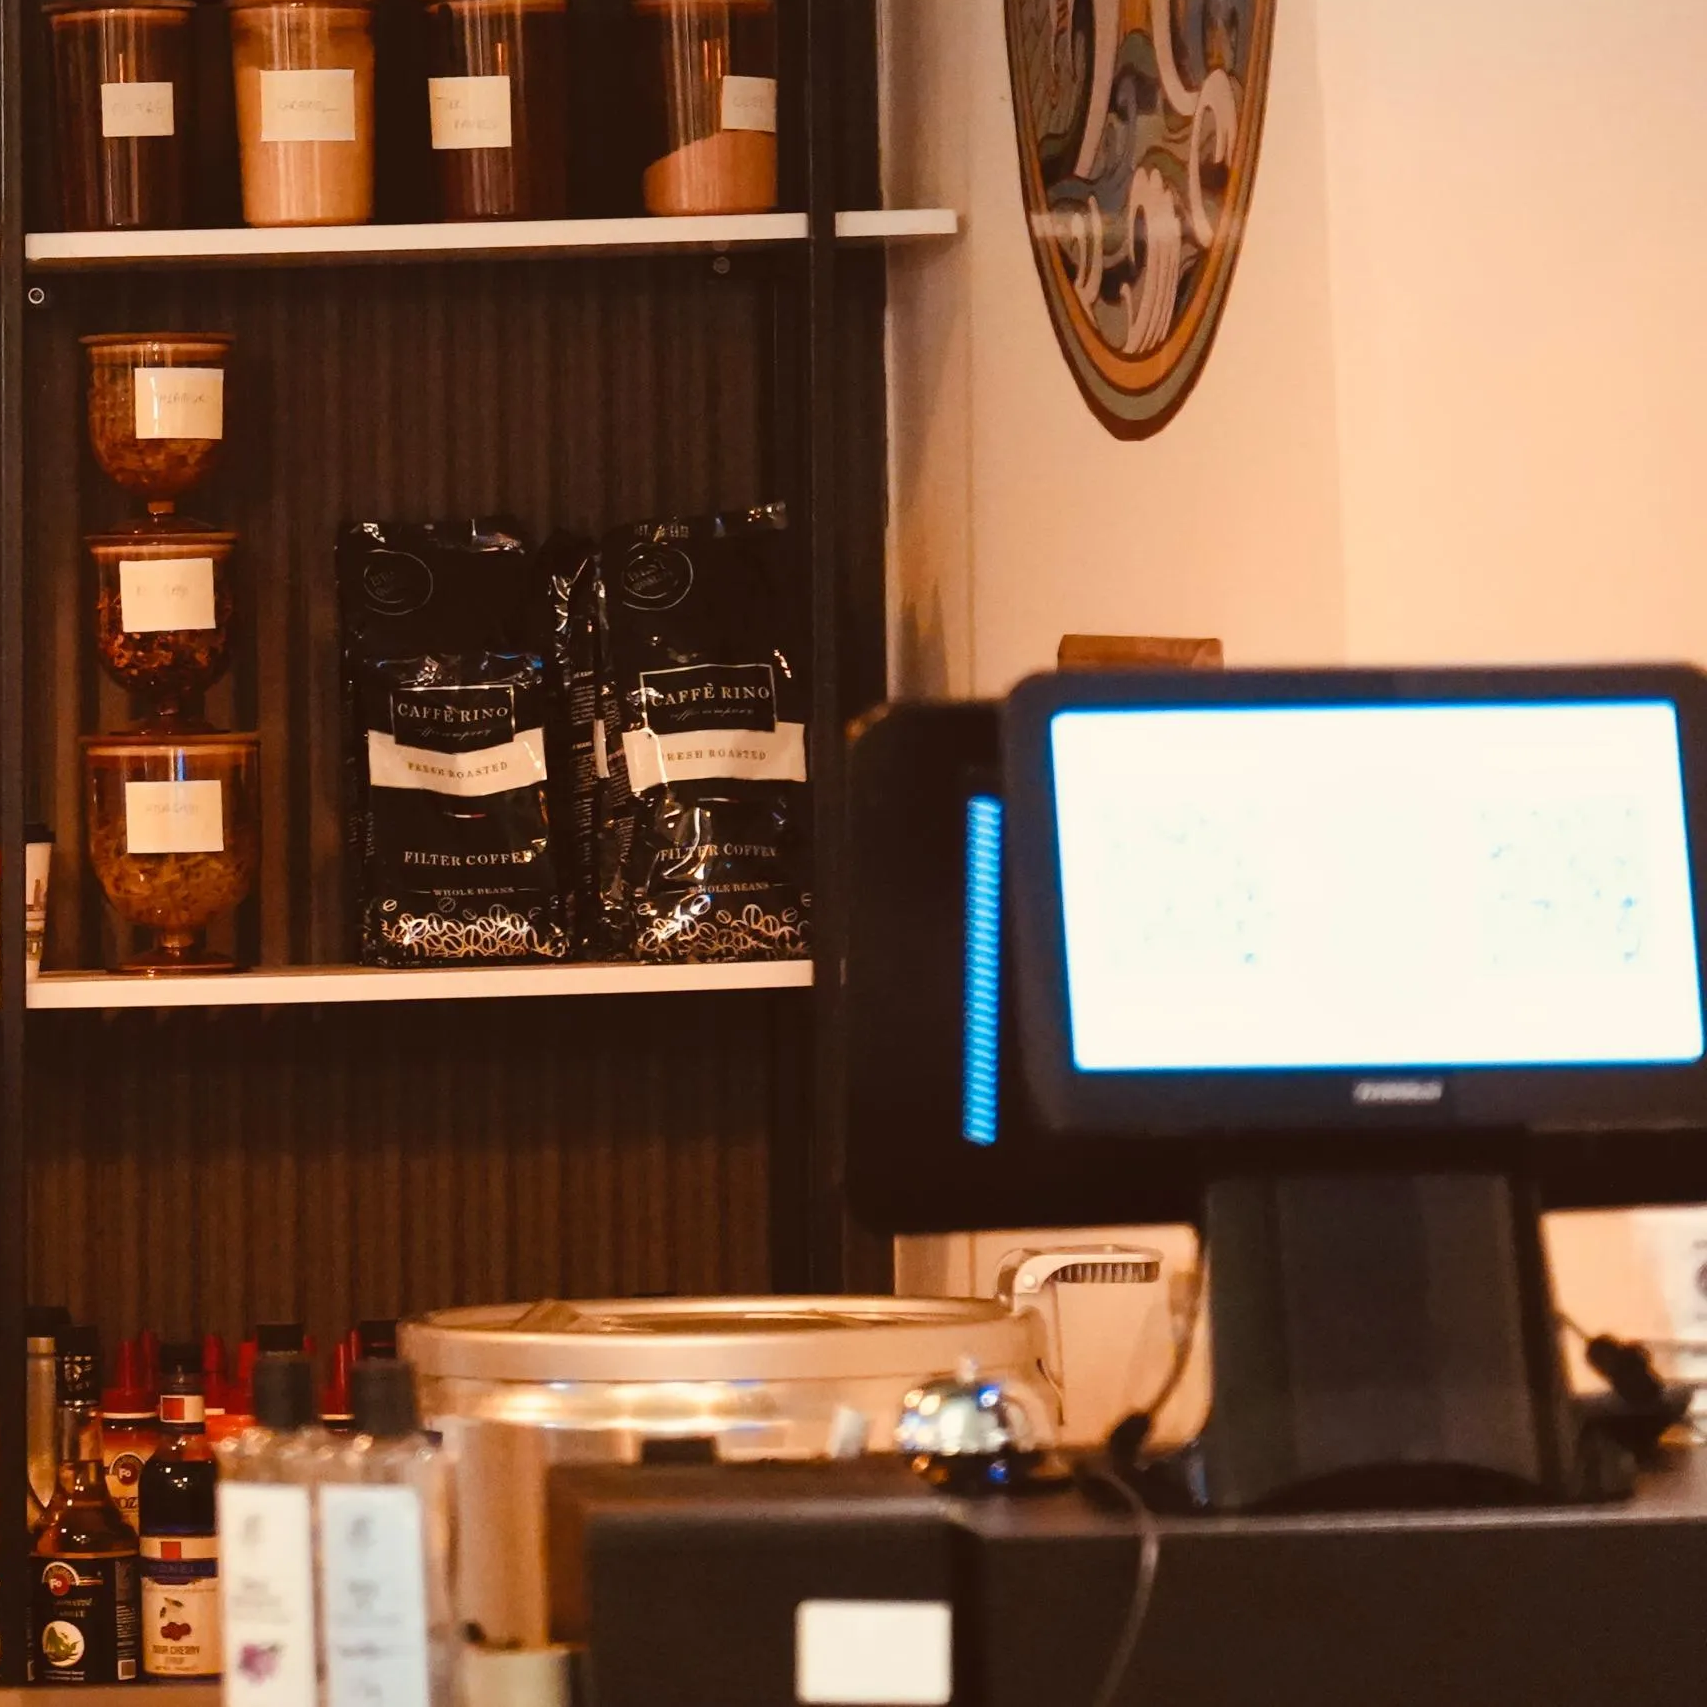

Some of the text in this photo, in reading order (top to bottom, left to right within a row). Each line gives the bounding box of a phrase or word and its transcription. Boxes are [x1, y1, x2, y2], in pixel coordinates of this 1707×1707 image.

[651, 683, 770, 707] CAFFÈ RINO
[397, 703, 509, 723] CAFFÈ RINO
[661, 749, 767, 762] RESH ROASTED
[448, 761, 508, 779] ROASTED
[404, 850, 462, 866] FILTER
[660, 844, 719, 862] FILTER
[433, 888, 475, 896] WHOLE
[733, 882, 769, 892] BEANS
